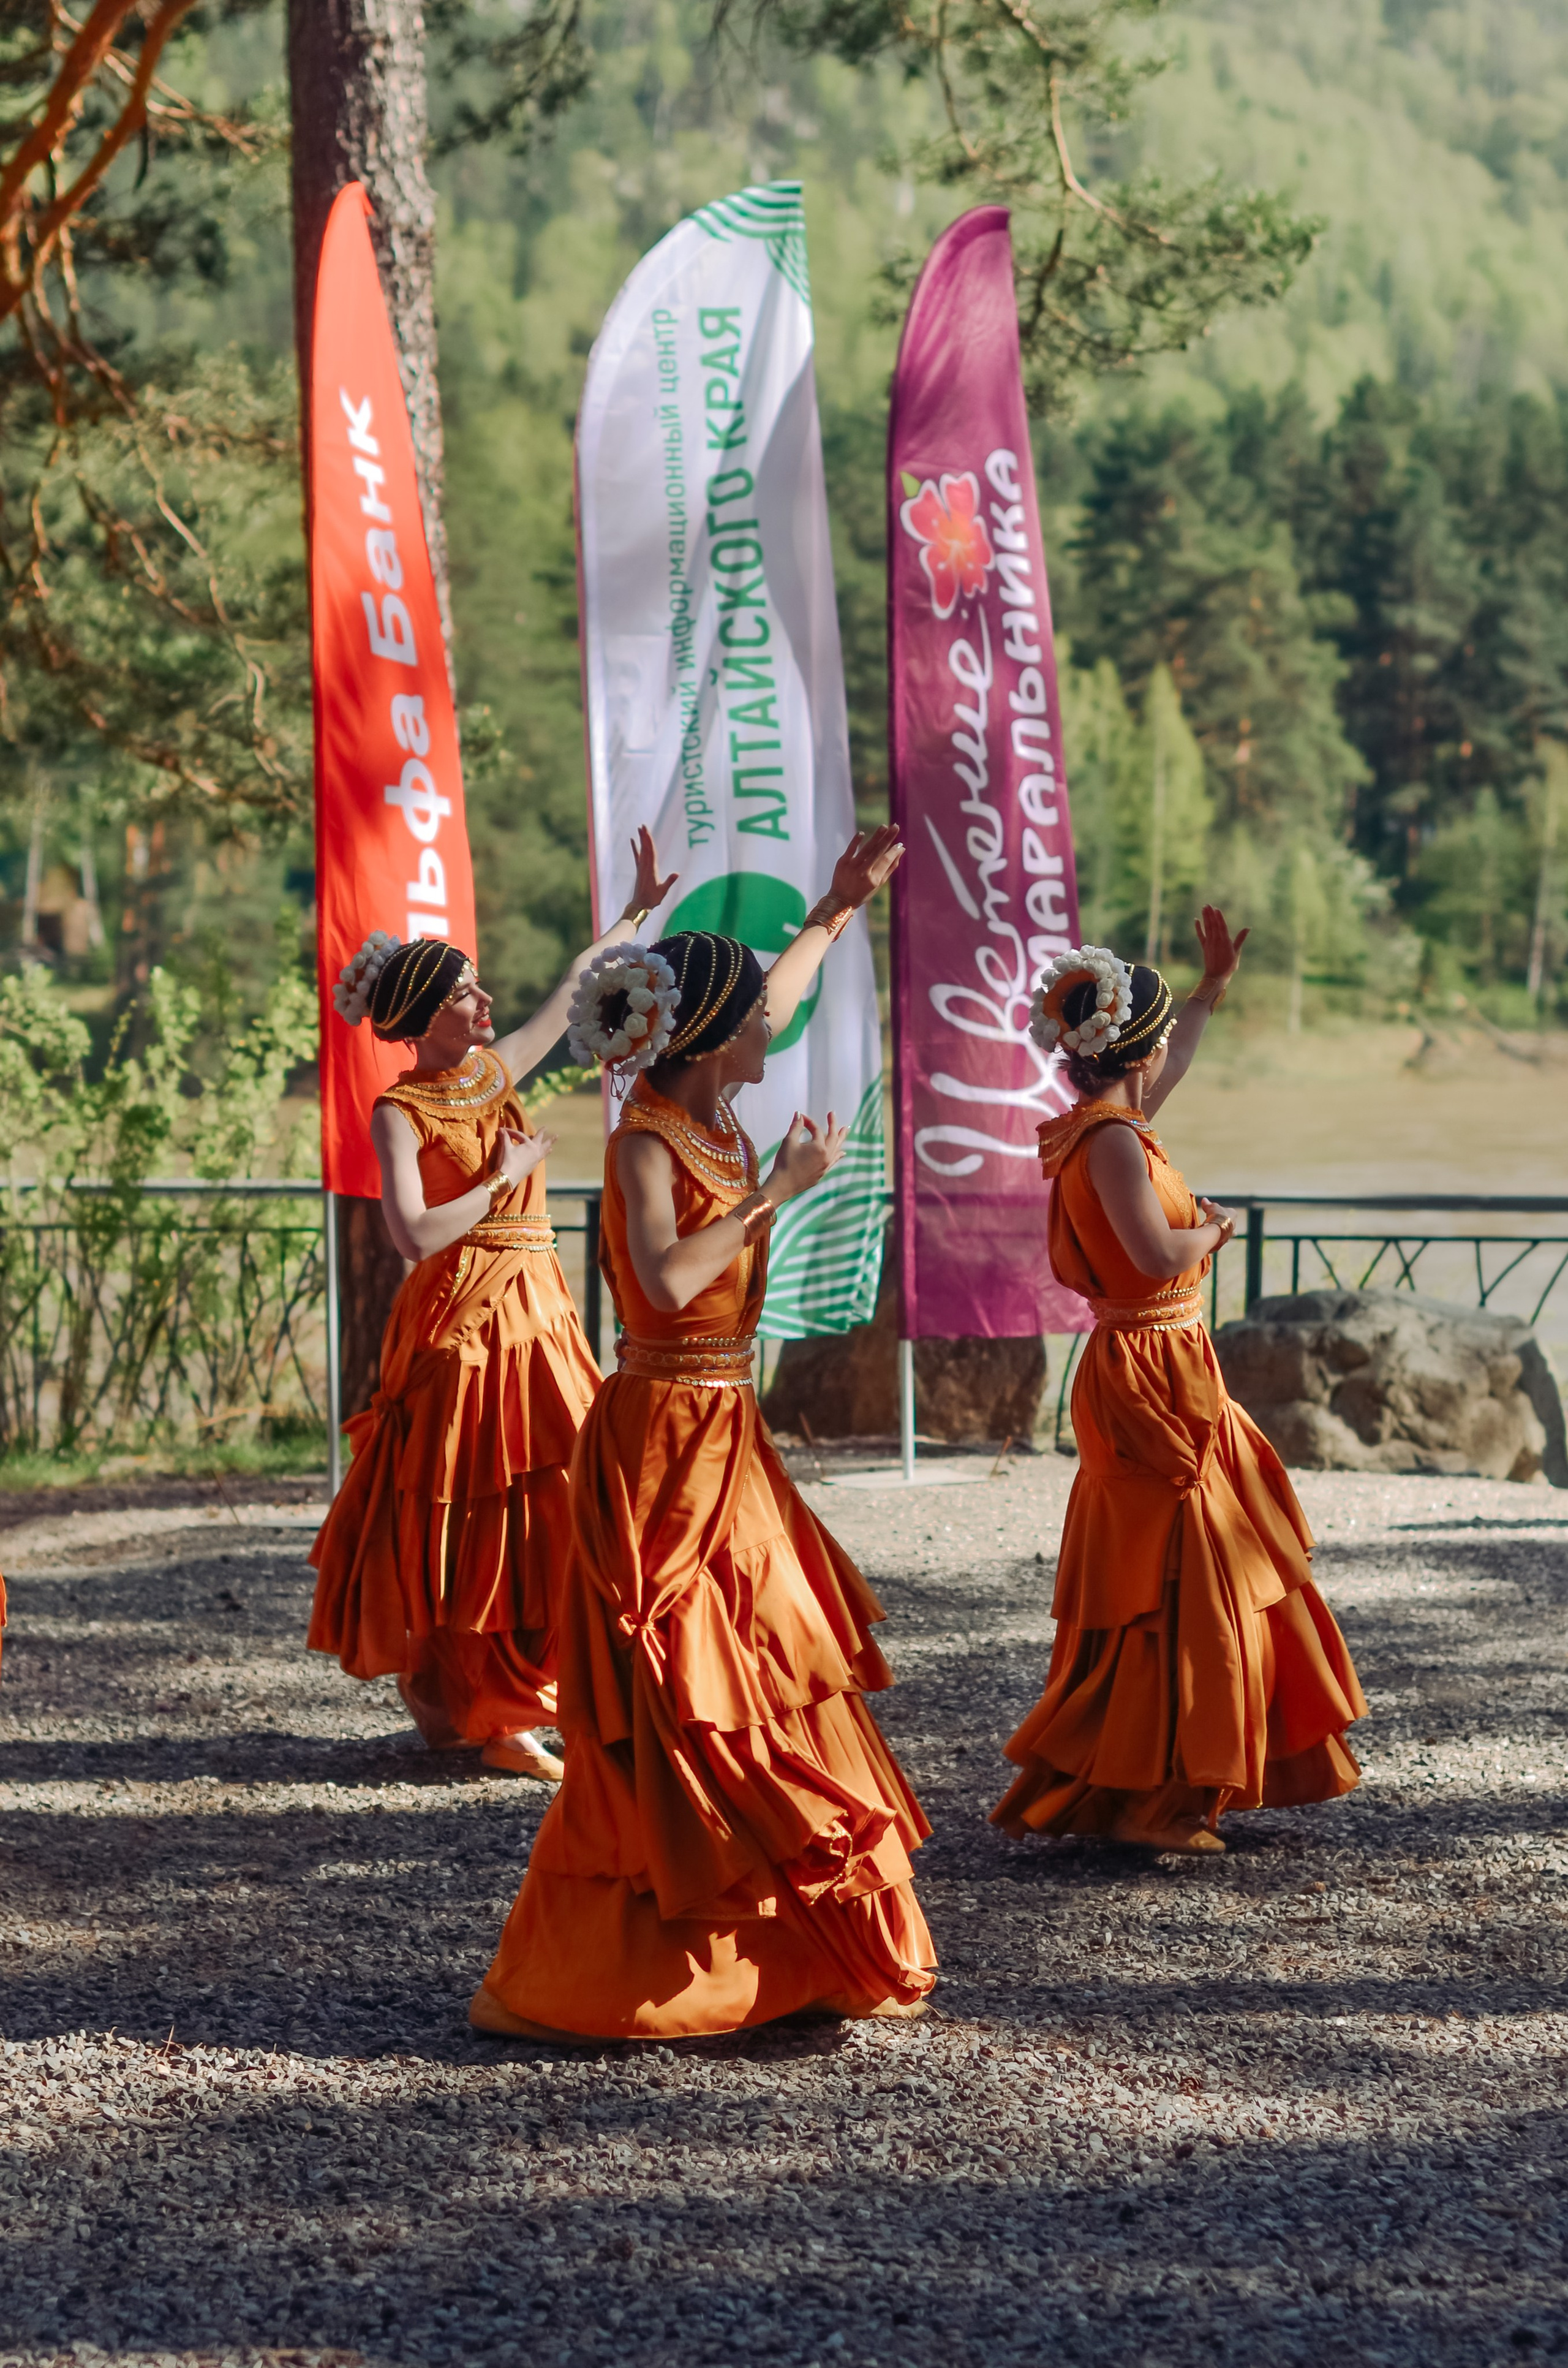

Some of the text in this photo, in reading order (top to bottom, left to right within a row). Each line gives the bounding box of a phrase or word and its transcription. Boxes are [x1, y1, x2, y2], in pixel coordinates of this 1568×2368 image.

[339, 385, 451, 944] льфа Банк
[652, 308, 715, 849] туристский информационный центр
[698, 307, 790, 841] АЛТАЙСКОГО КРАЯ
